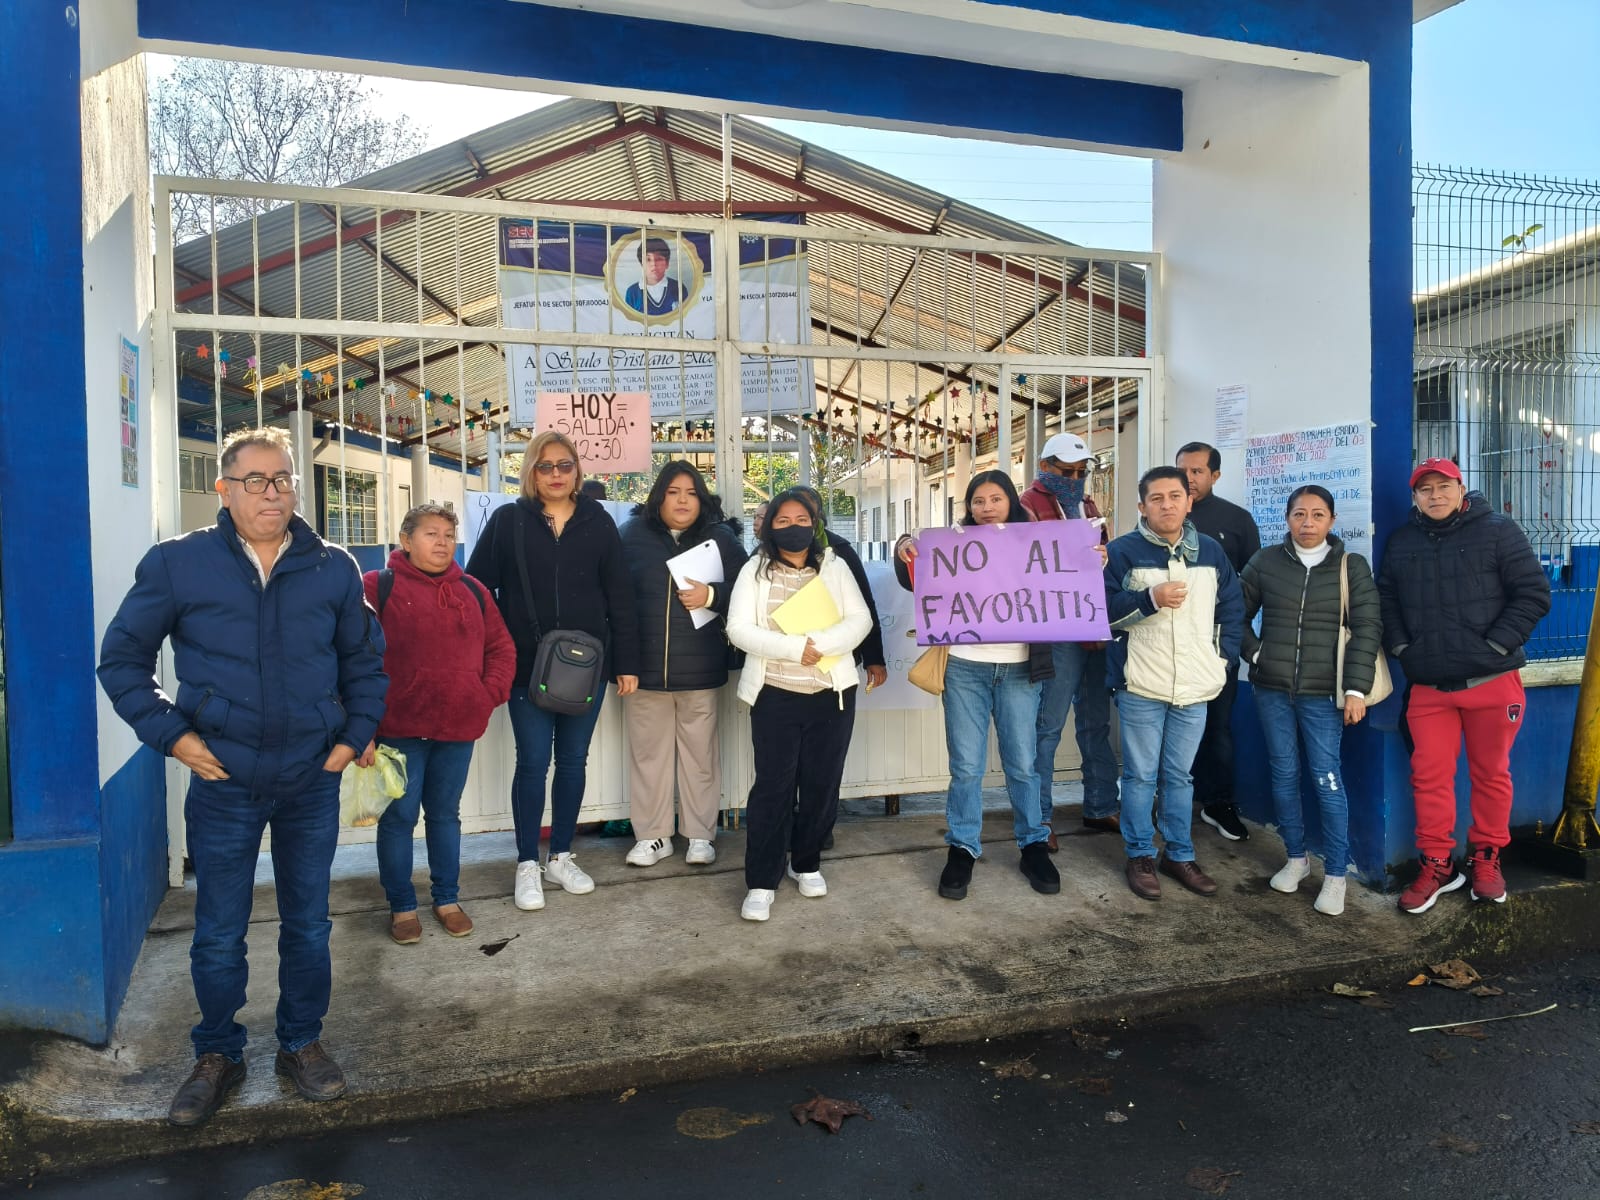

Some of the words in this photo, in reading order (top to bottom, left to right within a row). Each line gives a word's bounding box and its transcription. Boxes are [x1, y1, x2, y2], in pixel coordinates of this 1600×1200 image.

[524, 356, 537, 369] A
[608, 349, 675, 369] Cristano
[571, 393, 617, 420] HOY
[557, 415, 629, 436] SALIDA
[1334, 424, 1359, 437] GRADO
[932, 539, 989, 578] NO
[1025, 539, 1078, 574] AL
